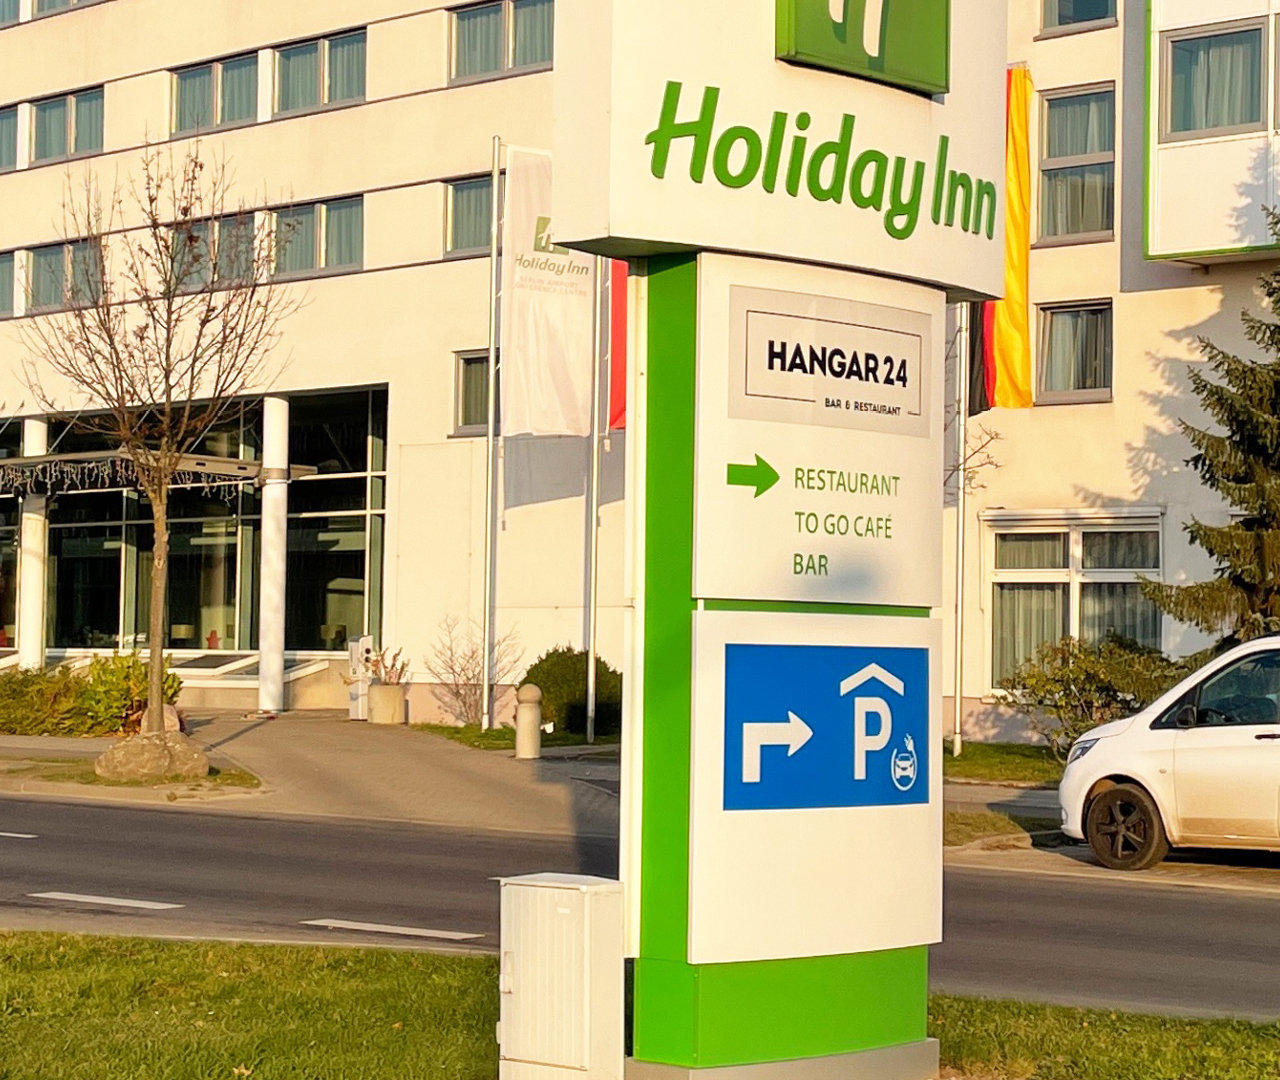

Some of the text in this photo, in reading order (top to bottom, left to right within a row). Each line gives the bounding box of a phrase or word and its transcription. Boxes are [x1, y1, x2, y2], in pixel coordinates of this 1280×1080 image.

[645, 80, 997, 240] Holiday Inn
[514, 253, 589, 276] Holiday Inn
[767, 340, 908, 388] HANGAR 24
[824, 397, 842, 409] BAR
[853, 401, 902, 417] RESTAURANT
[794, 467, 901, 497] RESTAURANT
[794, 511, 893, 539] TO GO CAFÉ
[793, 553, 829, 576] BAR
[853, 696, 893, 780] P
